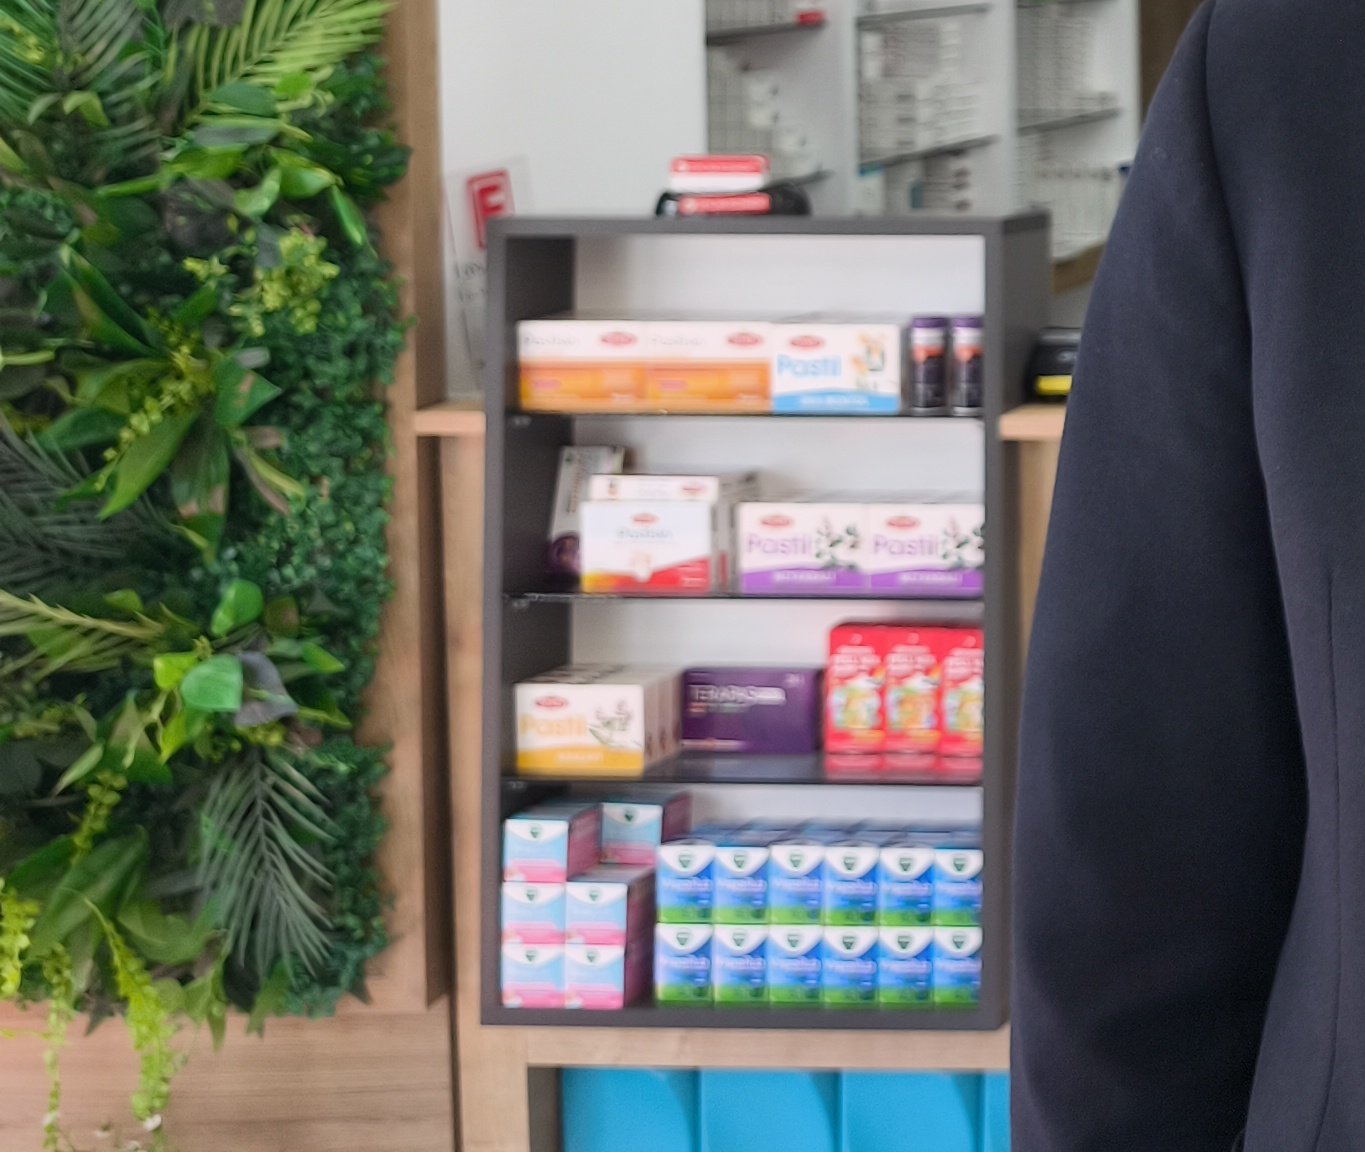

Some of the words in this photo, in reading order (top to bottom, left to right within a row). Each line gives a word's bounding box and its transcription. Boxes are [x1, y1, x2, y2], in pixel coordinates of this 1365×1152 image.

[776, 354, 842, 378] Pastil
[746, 534, 813, 556] Pastil
[873, 535, 939, 557] Pastil
